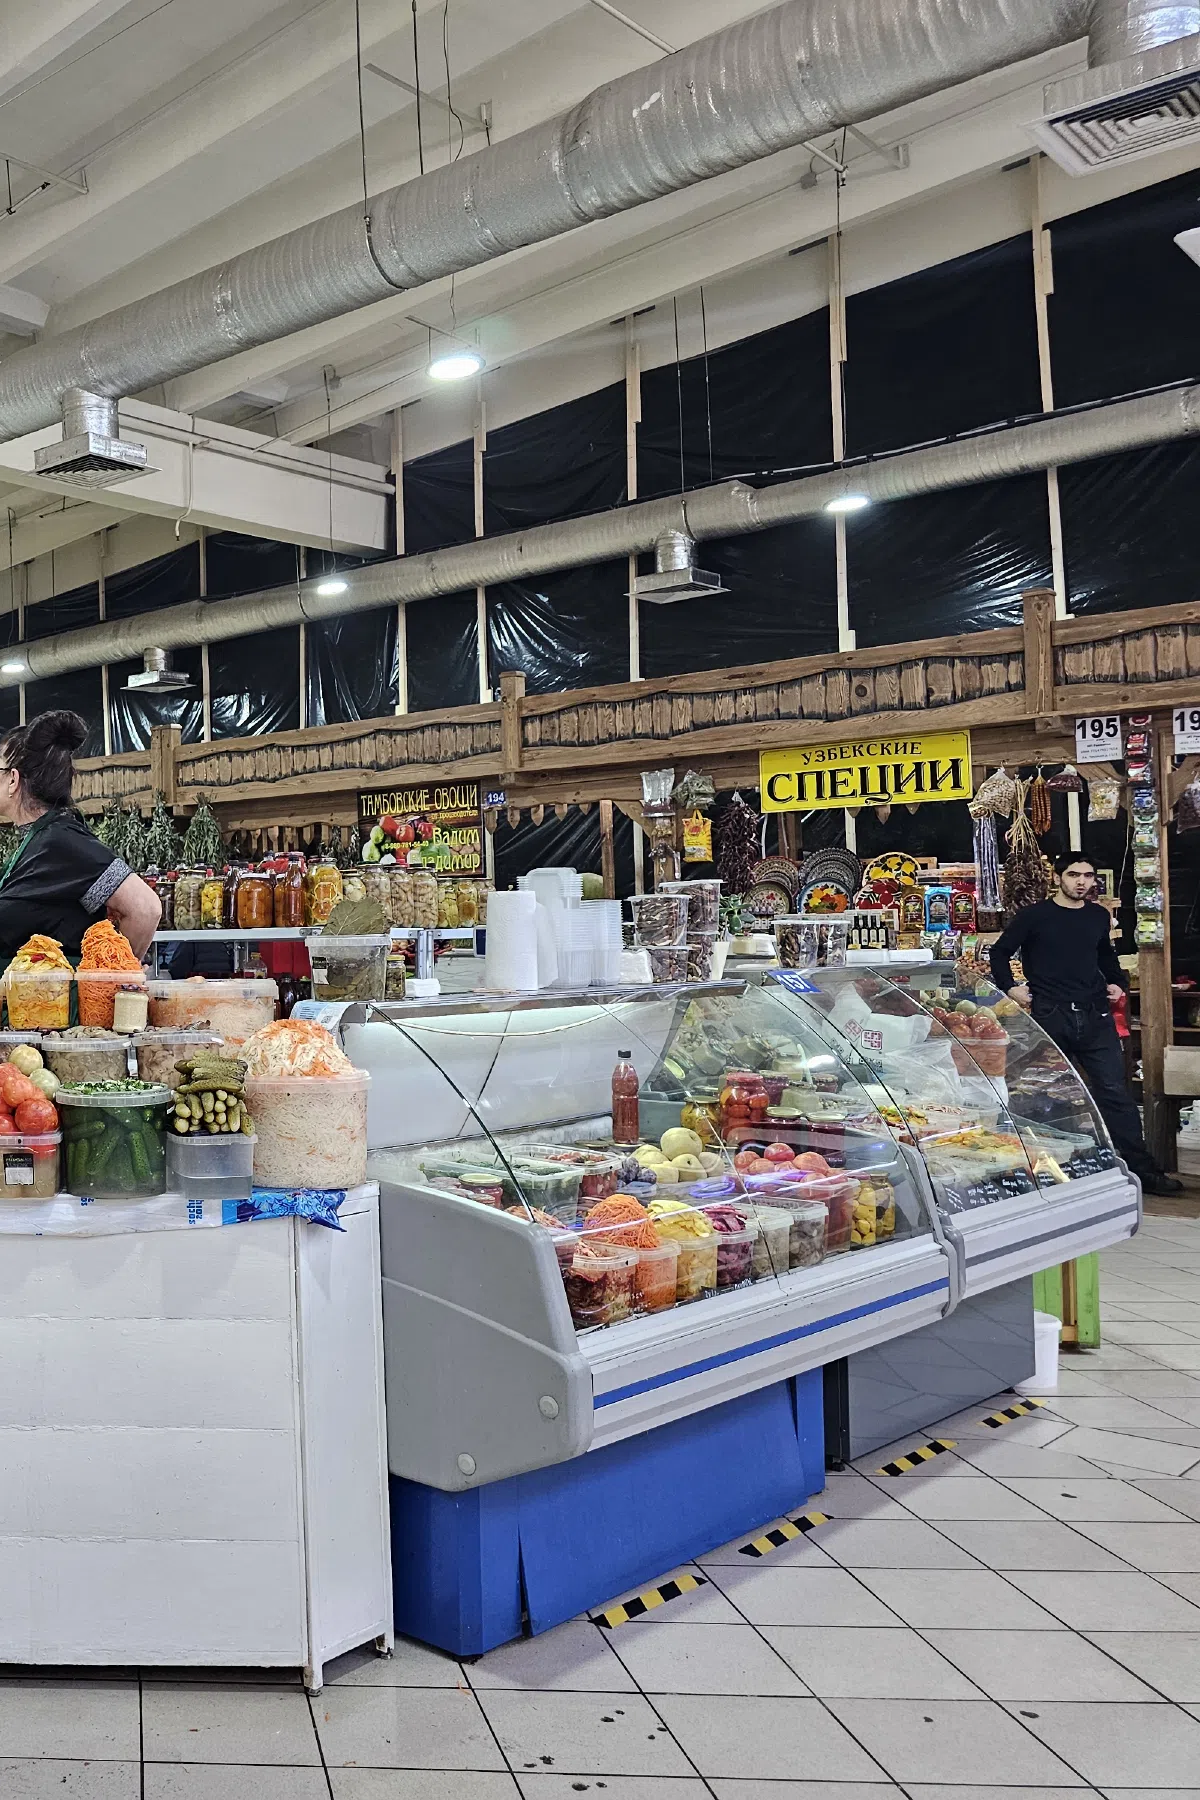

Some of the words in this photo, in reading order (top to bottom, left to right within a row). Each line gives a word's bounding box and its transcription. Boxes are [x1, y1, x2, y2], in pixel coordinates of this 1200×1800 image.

[1077, 718, 1118, 739] 195
[1175, 711, 1200, 731] 19
[801, 741, 922, 765] УЗБЕКСКИЕ
[767, 758, 964, 805] СПЕЦИИ
[361, 789, 430, 816] ТАМБОВСКИЕ
[434, 785, 478, 810] ОВОЩИ
[488, 792, 505, 802] 194
[432, 827, 480, 847] Вадим
[776, 974, 811, 990] 157
